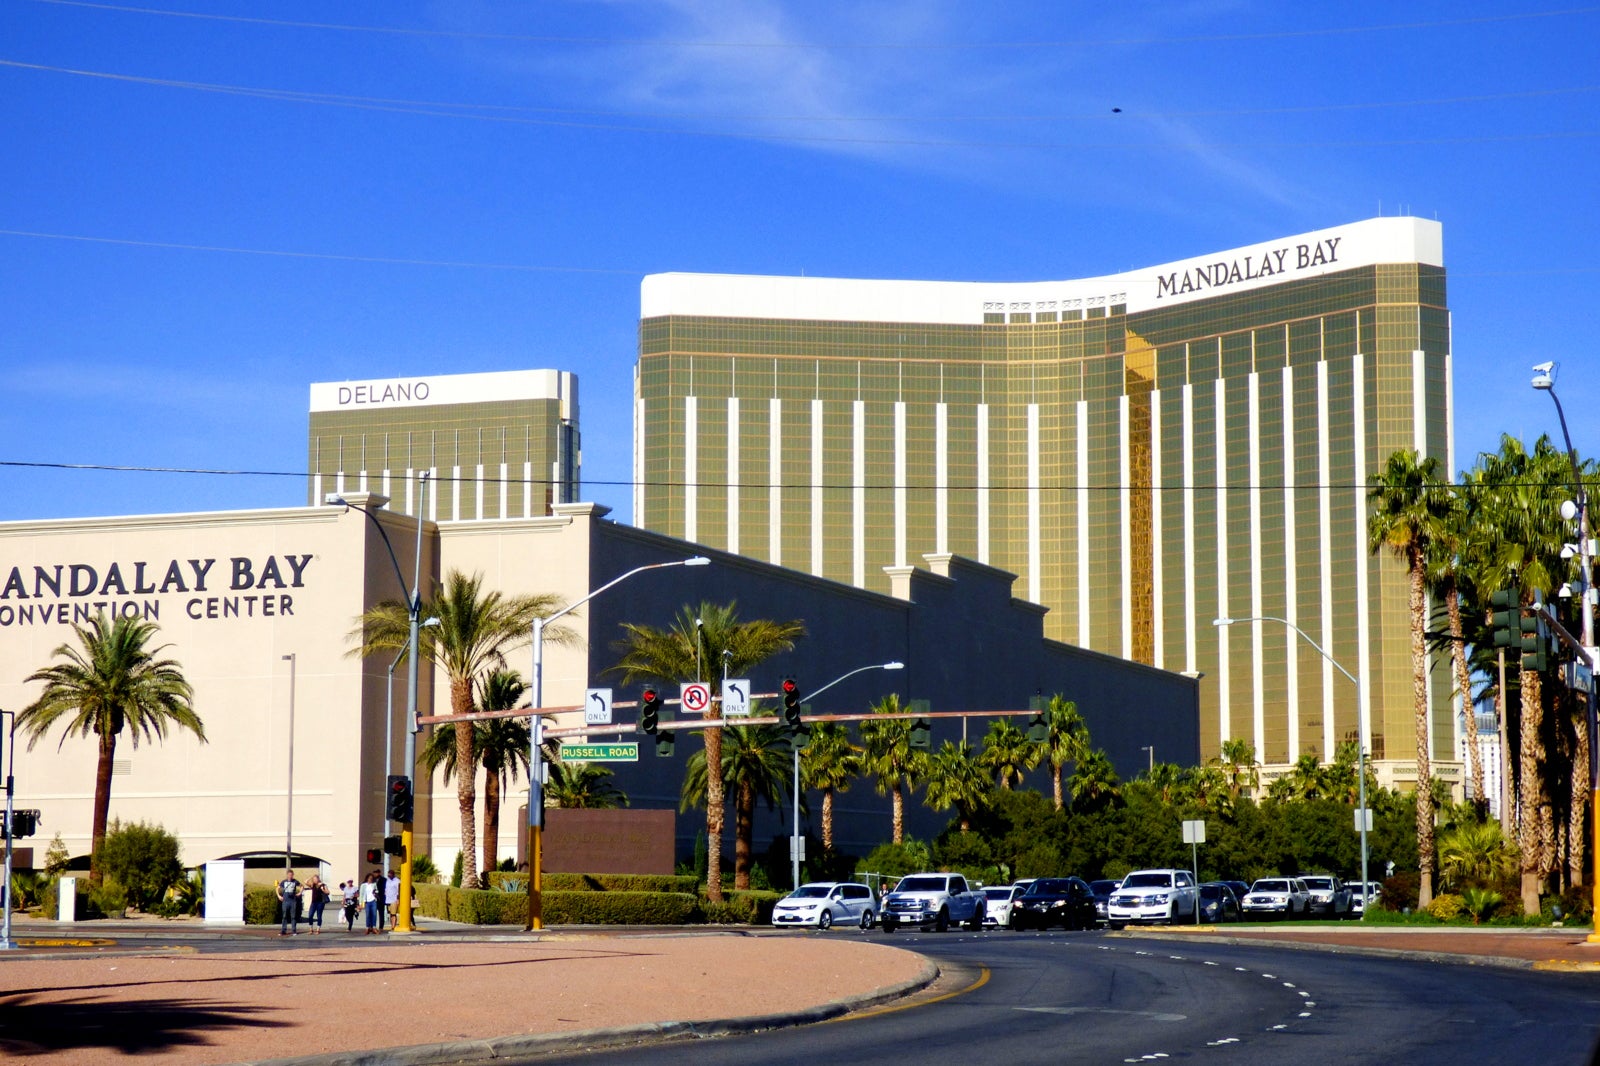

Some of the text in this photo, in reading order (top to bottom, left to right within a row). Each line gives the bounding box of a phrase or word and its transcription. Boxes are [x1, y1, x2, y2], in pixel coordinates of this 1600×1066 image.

[1156, 237, 1341, 299] MANDALAY BAY
[338, 382, 430, 405] DELANO
[0, 553, 314, 599] ANDALAY BAY
[186, 594, 295, 621] CENTER
[587, 713, 608, 721] ONLY
[725, 704, 746, 712] ONLY
[562, 747, 636, 757] RUSSELL ROAD
